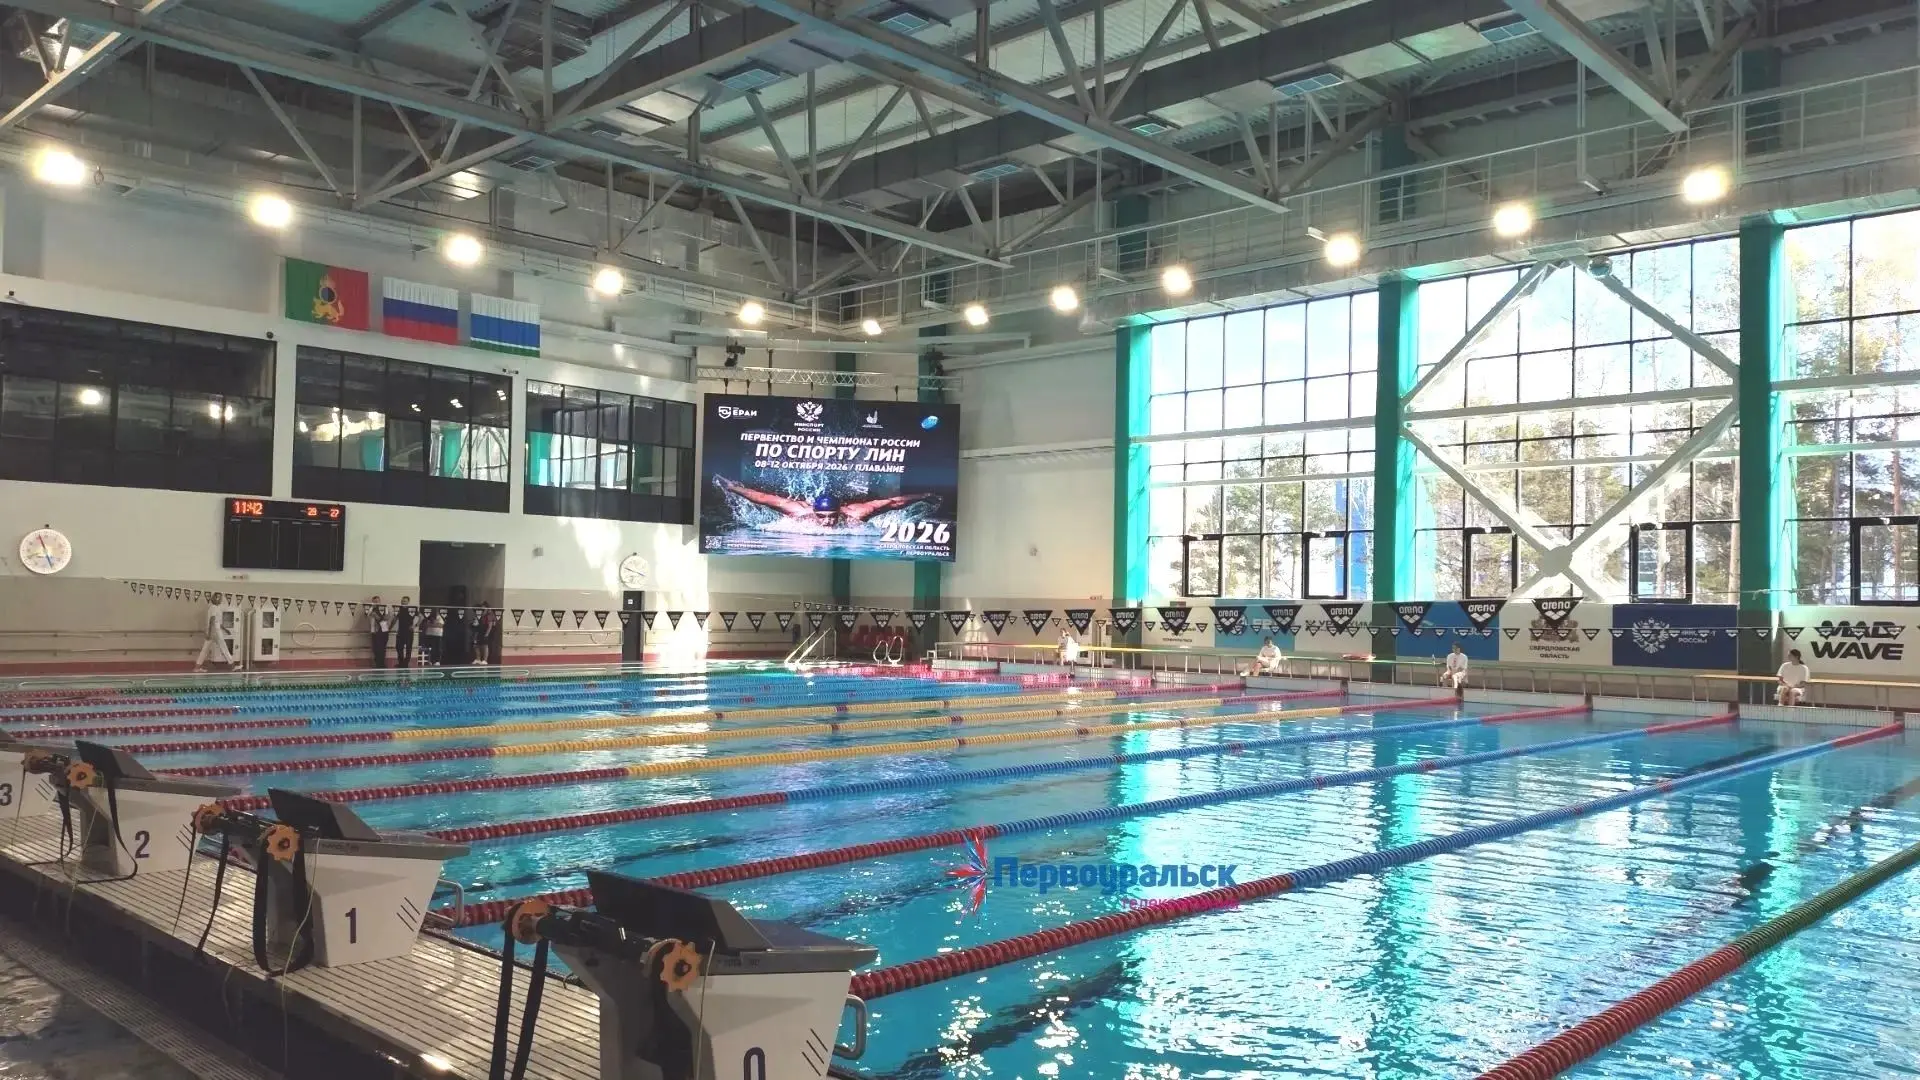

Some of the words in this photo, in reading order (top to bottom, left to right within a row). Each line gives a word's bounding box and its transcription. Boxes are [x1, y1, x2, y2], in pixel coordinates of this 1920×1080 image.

[741, 433, 804, 443] ПЕРВЕНСТВО
[806, 435, 815, 444] И
[816, 436, 879, 446] ЧЕМПИОНАТ
[880, 439, 921, 448] РОССИИ
[755, 443, 783, 458] ПО
[787, 445, 861, 460] СПОРТУ
[863, 448, 906, 462] ЛИН
[754, 460, 780, 469] 08-12
[781, 461, 824, 470] ОКТЯБРЯ
[825, 462, 848, 471] 2026
[855, 464, 905, 473] ПЛАВАНИЕ
[234, 501, 263, 515] 11:42
[880, 521, 951, 544] 2026
[1399, 606, 1424, 614] arena
[1468, 604, 1496, 613] arena
[1542, 600, 1571, 610] arena
[1116, 611, 1135, 619] arena
[1165, 610, 1185, 618] arena
[1218, 609, 1239, 617] arena
[1330, 607, 1354, 616] arena
[1529, 645, 1581, 653] СВЕРДЛОВСКАЯ
[1811, 641, 1904, 660] WAVE
[134, 830, 150, 859] 2
[345, 907, 356, 944] 1
